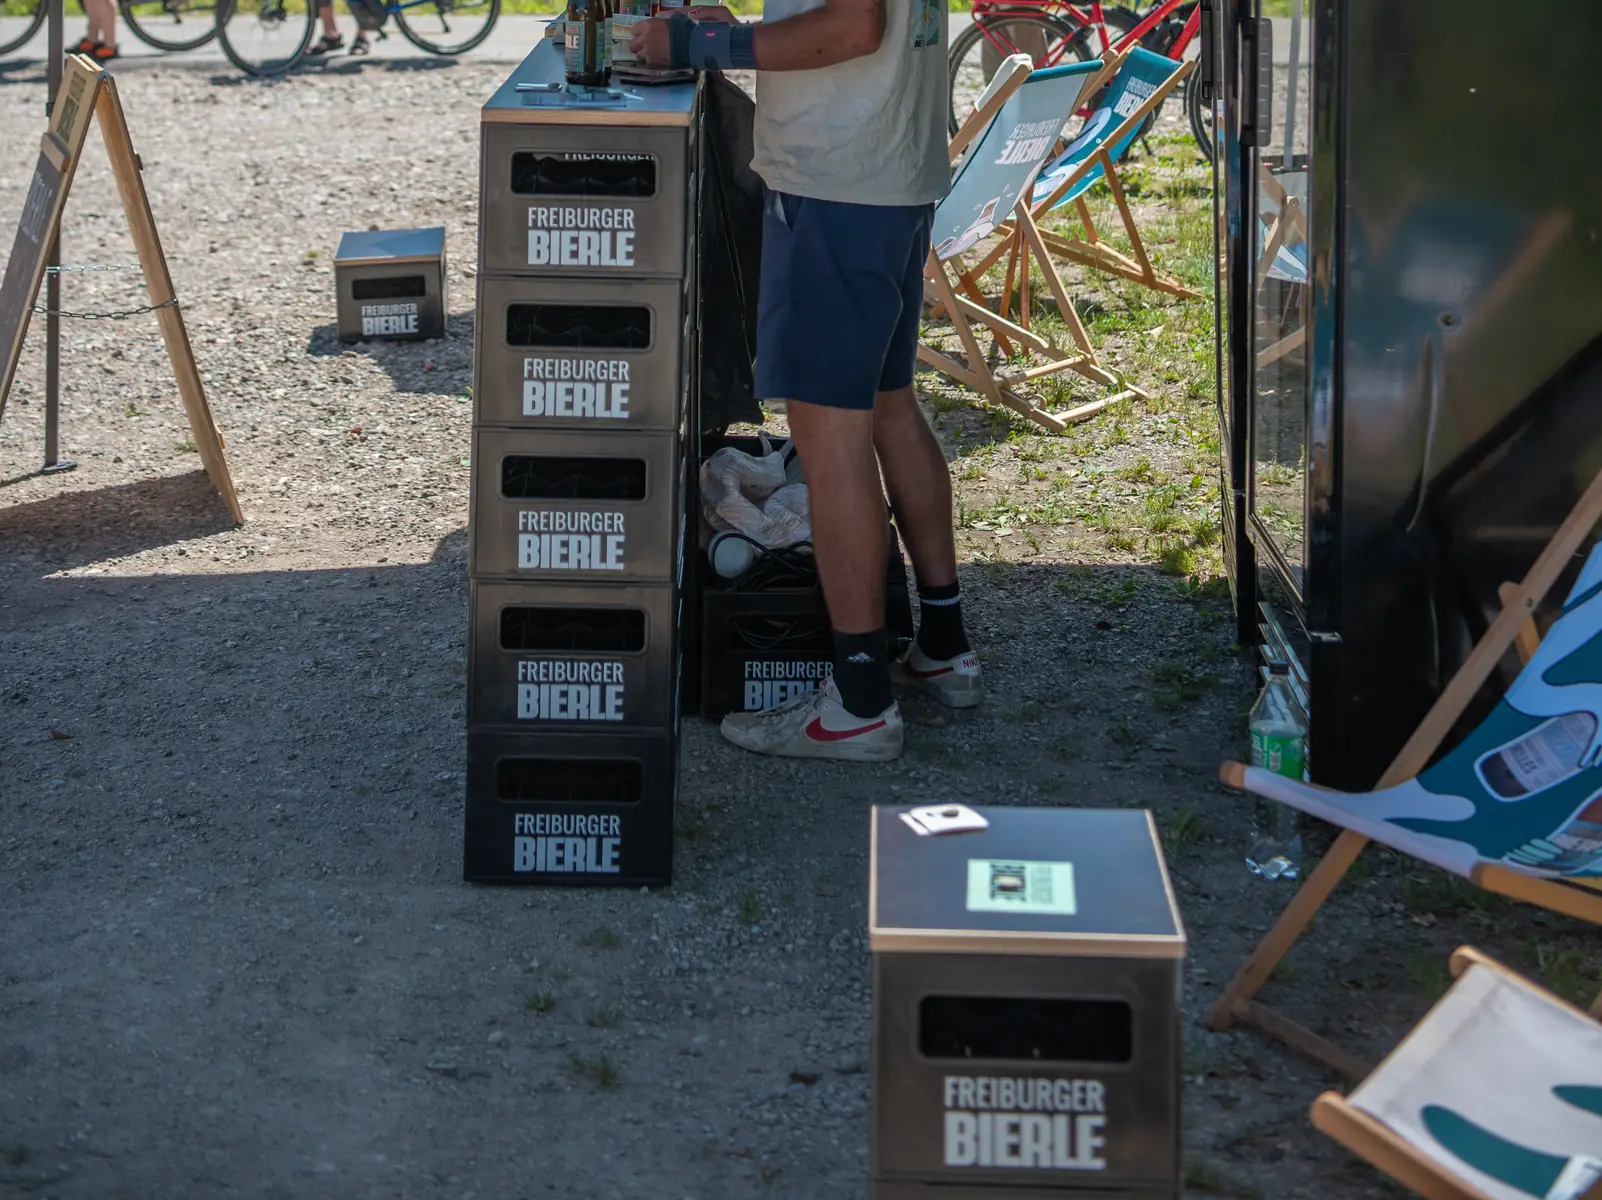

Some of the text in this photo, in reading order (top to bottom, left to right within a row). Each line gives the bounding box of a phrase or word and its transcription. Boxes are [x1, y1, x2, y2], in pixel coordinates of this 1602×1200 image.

[527, 206, 635, 229] FREIBURGER
[527, 229, 635, 266] BIERLE
[361, 303, 417, 316] FREIBURGER
[361, 314, 419, 336] BIERLE
[523, 357, 630, 381] FREIBURGER
[522, 380, 630, 419] BIERLE
[518, 511, 625, 533] FREIBURGER
[518, 533, 625, 570] BIERLE
[517, 660, 624, 683] FREIBURGER
[744, 661, 834, 679] FREIBURGER
[517, 683, 624, 721] BIERLE
[514, 813, 621, 836] FREIBURGER
[513, 836, 622, 873] BIERLE
[943, 1075, 1106, 1111] FREIBURGER
[943, 1111, 1107, 1170] BIERLE
